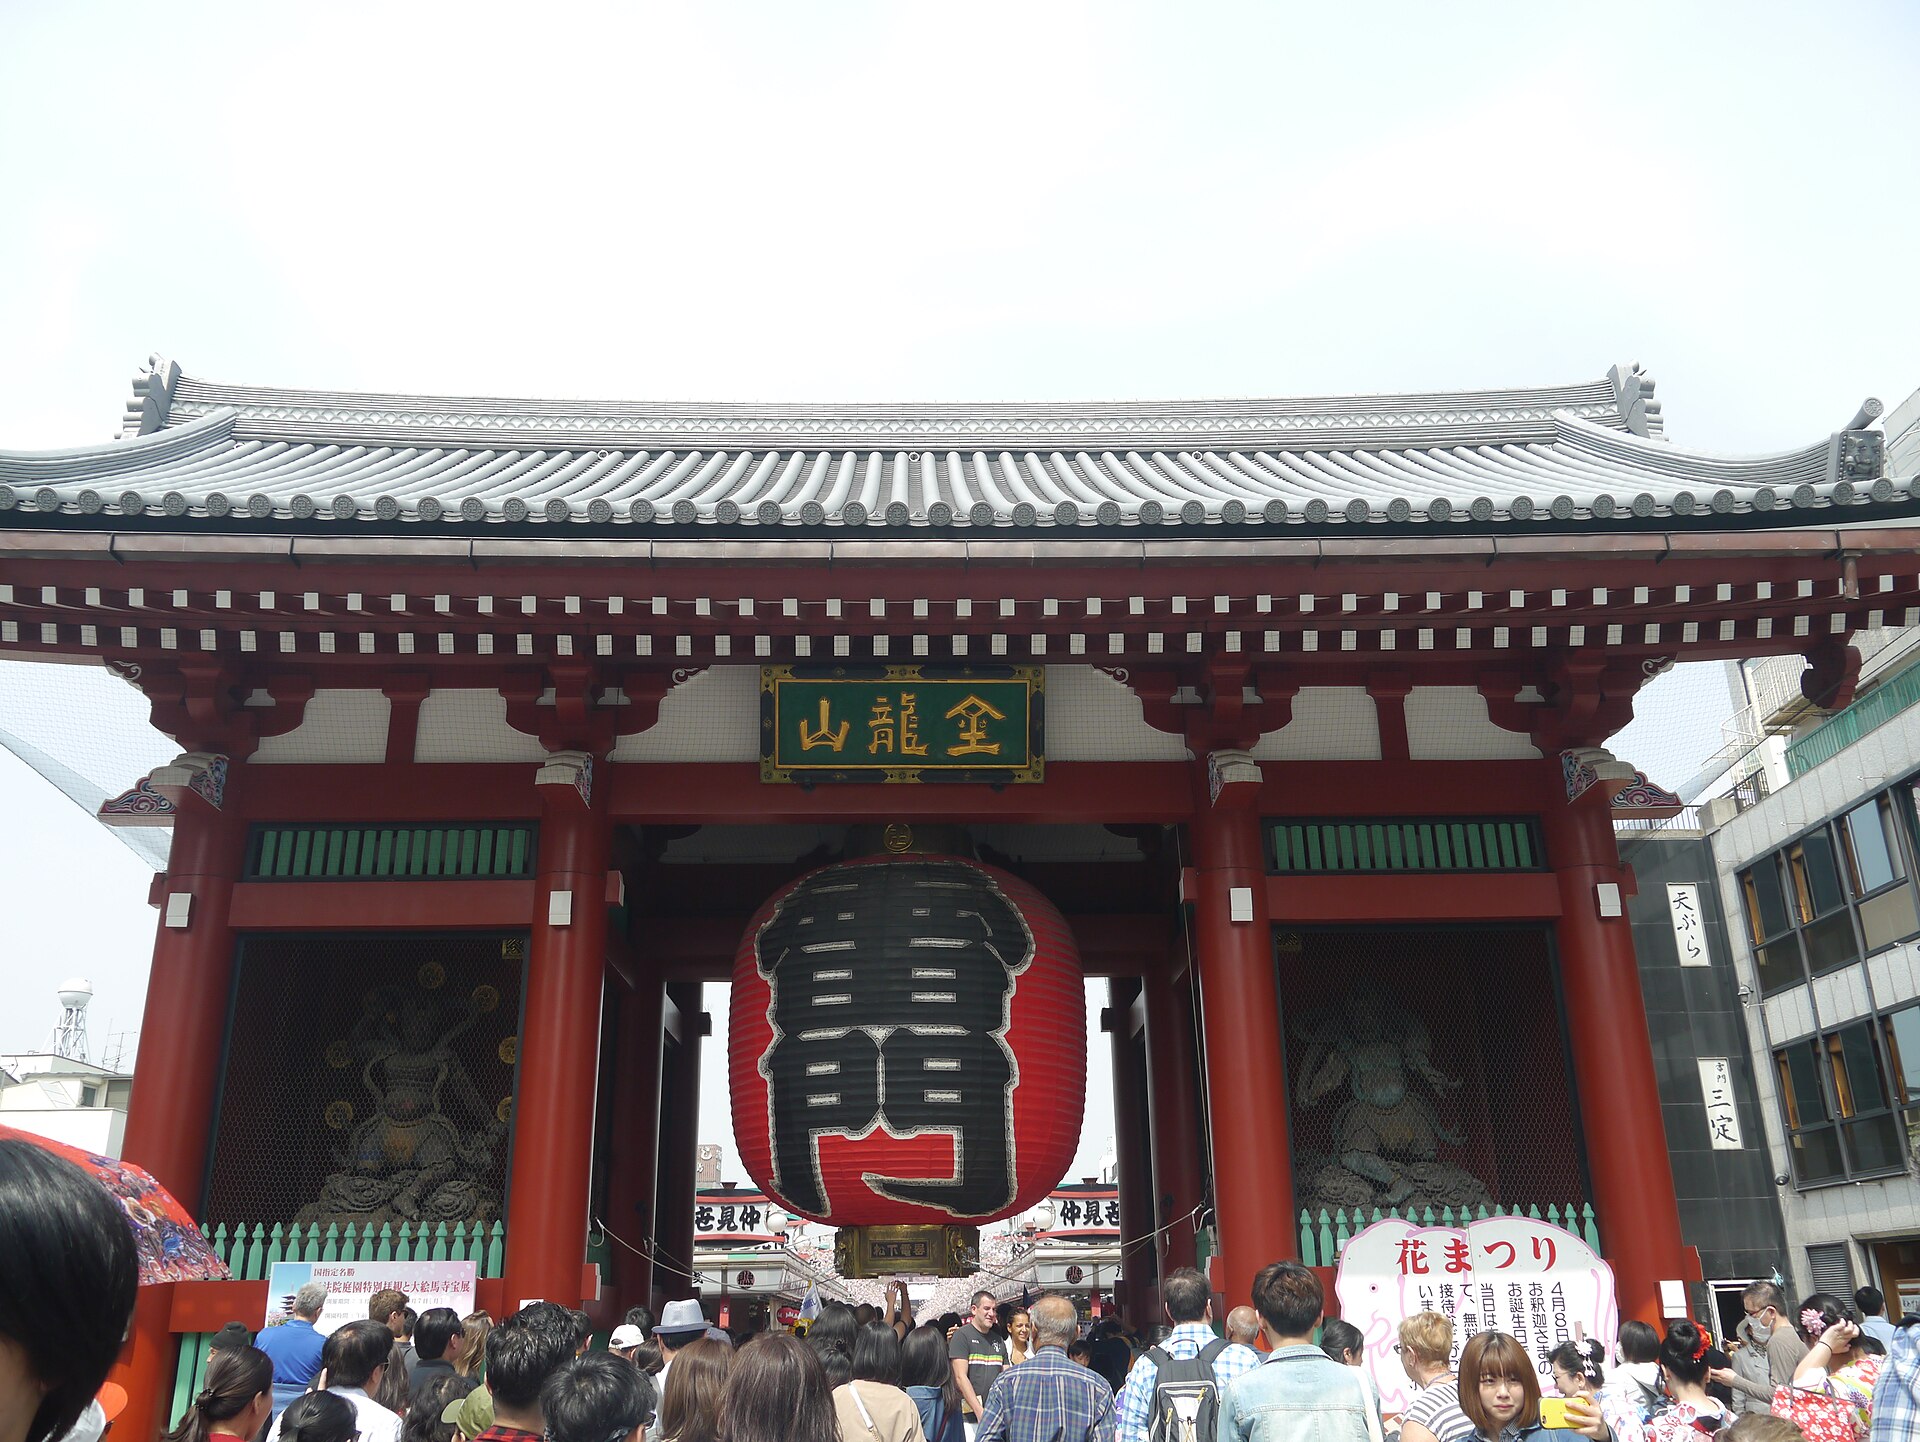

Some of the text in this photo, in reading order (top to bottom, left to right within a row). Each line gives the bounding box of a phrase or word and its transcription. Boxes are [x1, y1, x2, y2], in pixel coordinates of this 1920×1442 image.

[1672, 891, 1701, 958] 天ぷら
[1707, 1089, 1738, 1142] 三定
[873, 1243, 925, 1257] 松下電器
[1395, 1236, 1557, 1276] 花まつり
[318, 1280, 471, 1294] 法院庭園特別拝観と大絵馬寺宝展
[1480, 1283, 1498, 1332] 当日は
[1551, 1281, 1570, 1343] 4月8日
[1528, 1281, 1553, 1375] お釈迦さまの
